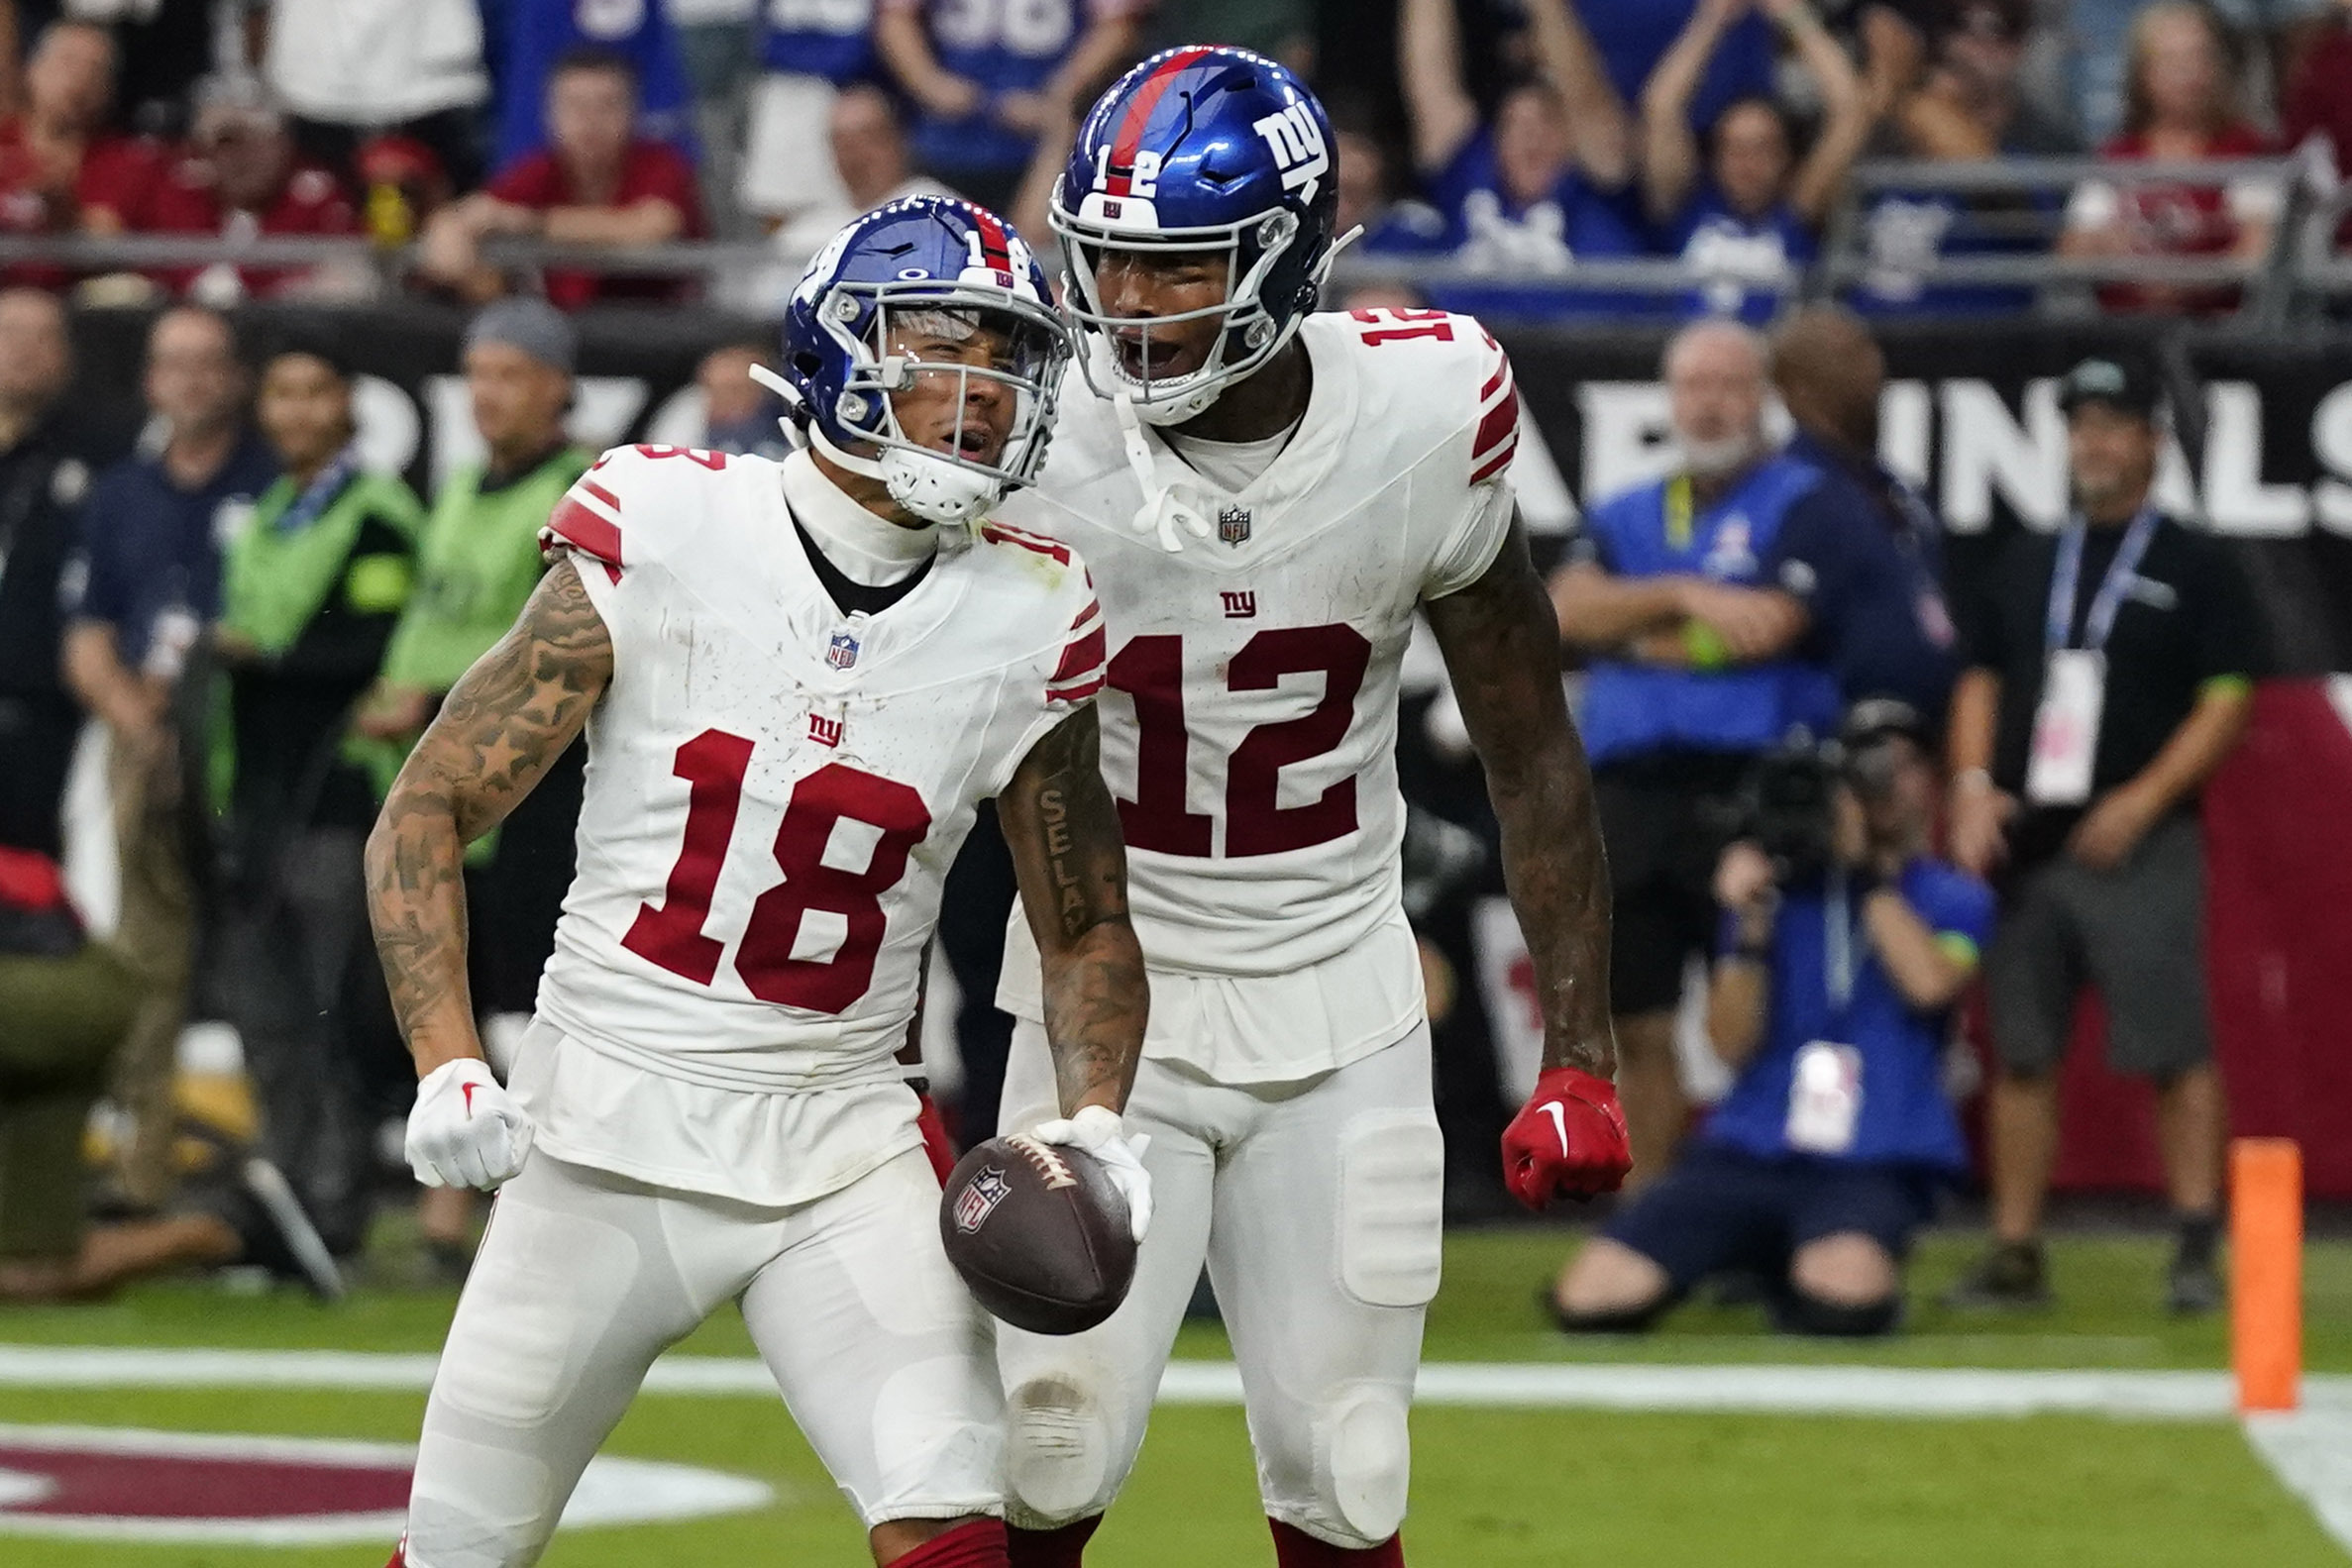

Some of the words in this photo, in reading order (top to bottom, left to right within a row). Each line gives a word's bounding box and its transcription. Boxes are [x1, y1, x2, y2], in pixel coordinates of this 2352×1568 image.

[1252, 100, 1330, 191] ny
[1219, 590, 1256, 618] ny
[807, 712, 842, 749] ny
[1106, 622, 1372, 858] 12
[620, 727, 932, 1015] 18
[956, 1188, 987, 1226] NFL
